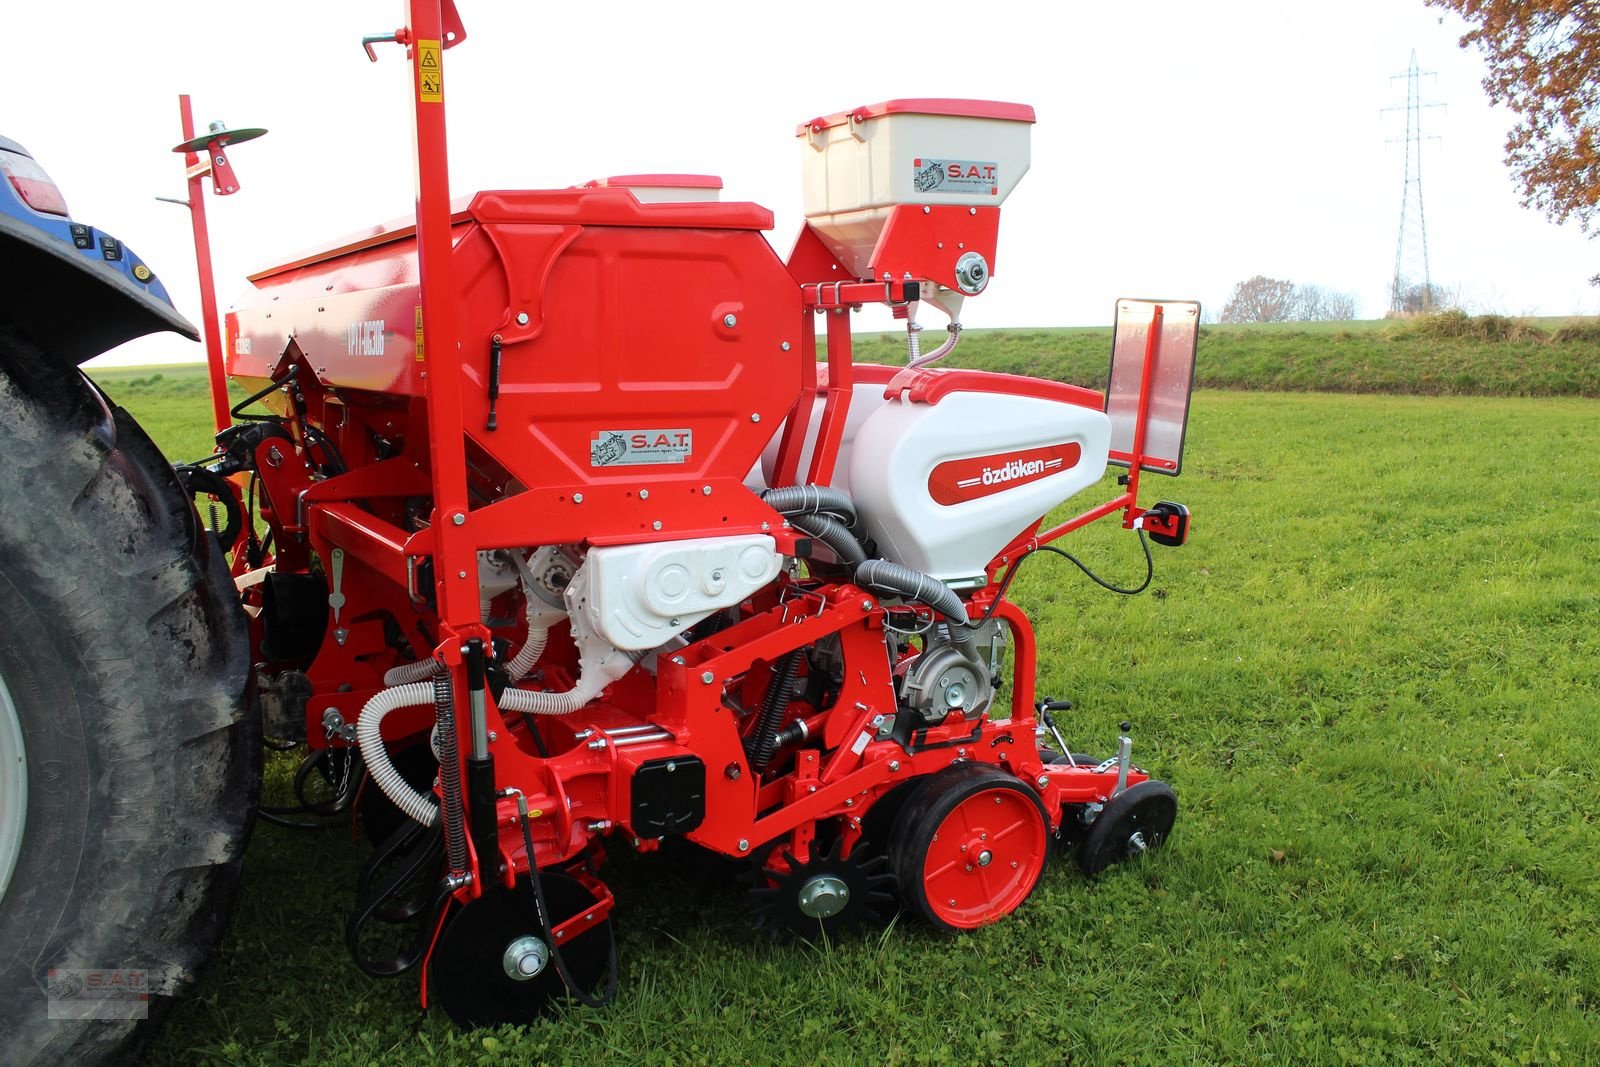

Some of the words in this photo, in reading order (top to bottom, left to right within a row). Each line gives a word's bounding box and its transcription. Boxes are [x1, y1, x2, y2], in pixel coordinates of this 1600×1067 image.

[947, 163, 996, 180] S.A.T.
[630, 433, 689, 449] S.A.T.
[982, 459, 1045, 486] özdöken
